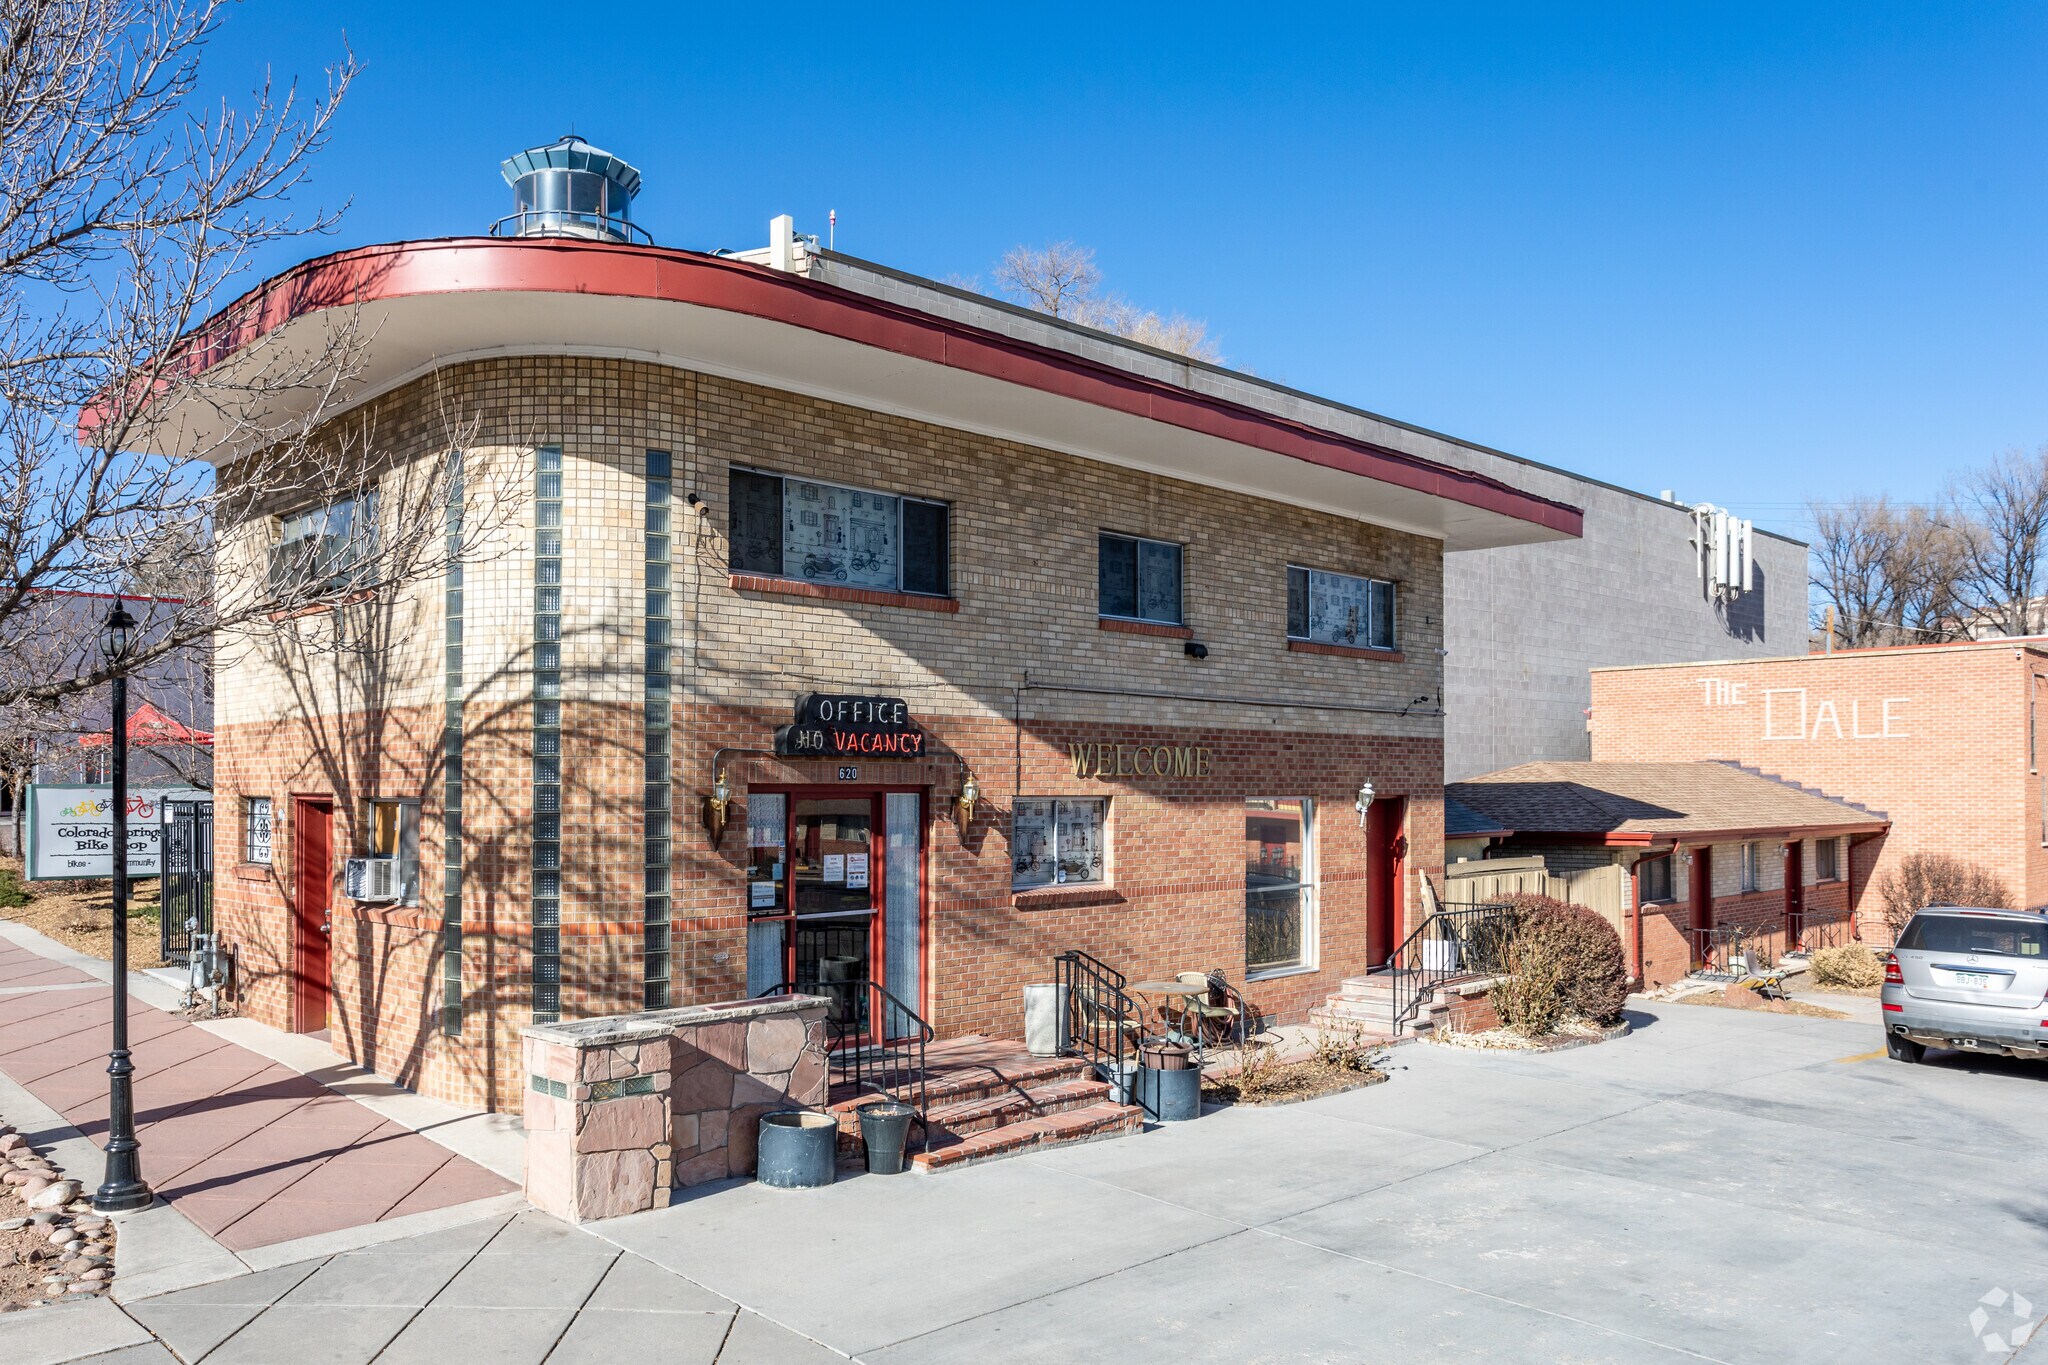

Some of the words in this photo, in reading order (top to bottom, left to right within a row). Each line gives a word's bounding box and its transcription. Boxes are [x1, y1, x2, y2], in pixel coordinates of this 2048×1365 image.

[820, 699, 906, 724] OFFICE
[1696, 678, 1748, 705] THE
[1761, 688, 1912, 741] DALE
[795, 730, 823, 750] NO
[834, 731, 922, 753] VACANCY
[1068, 742, 1212, 777] WELCOME
[839, 767, 858, 780] 620
[75, 839, 109, 851] Bike
[126, 827, 162, 842] prings
